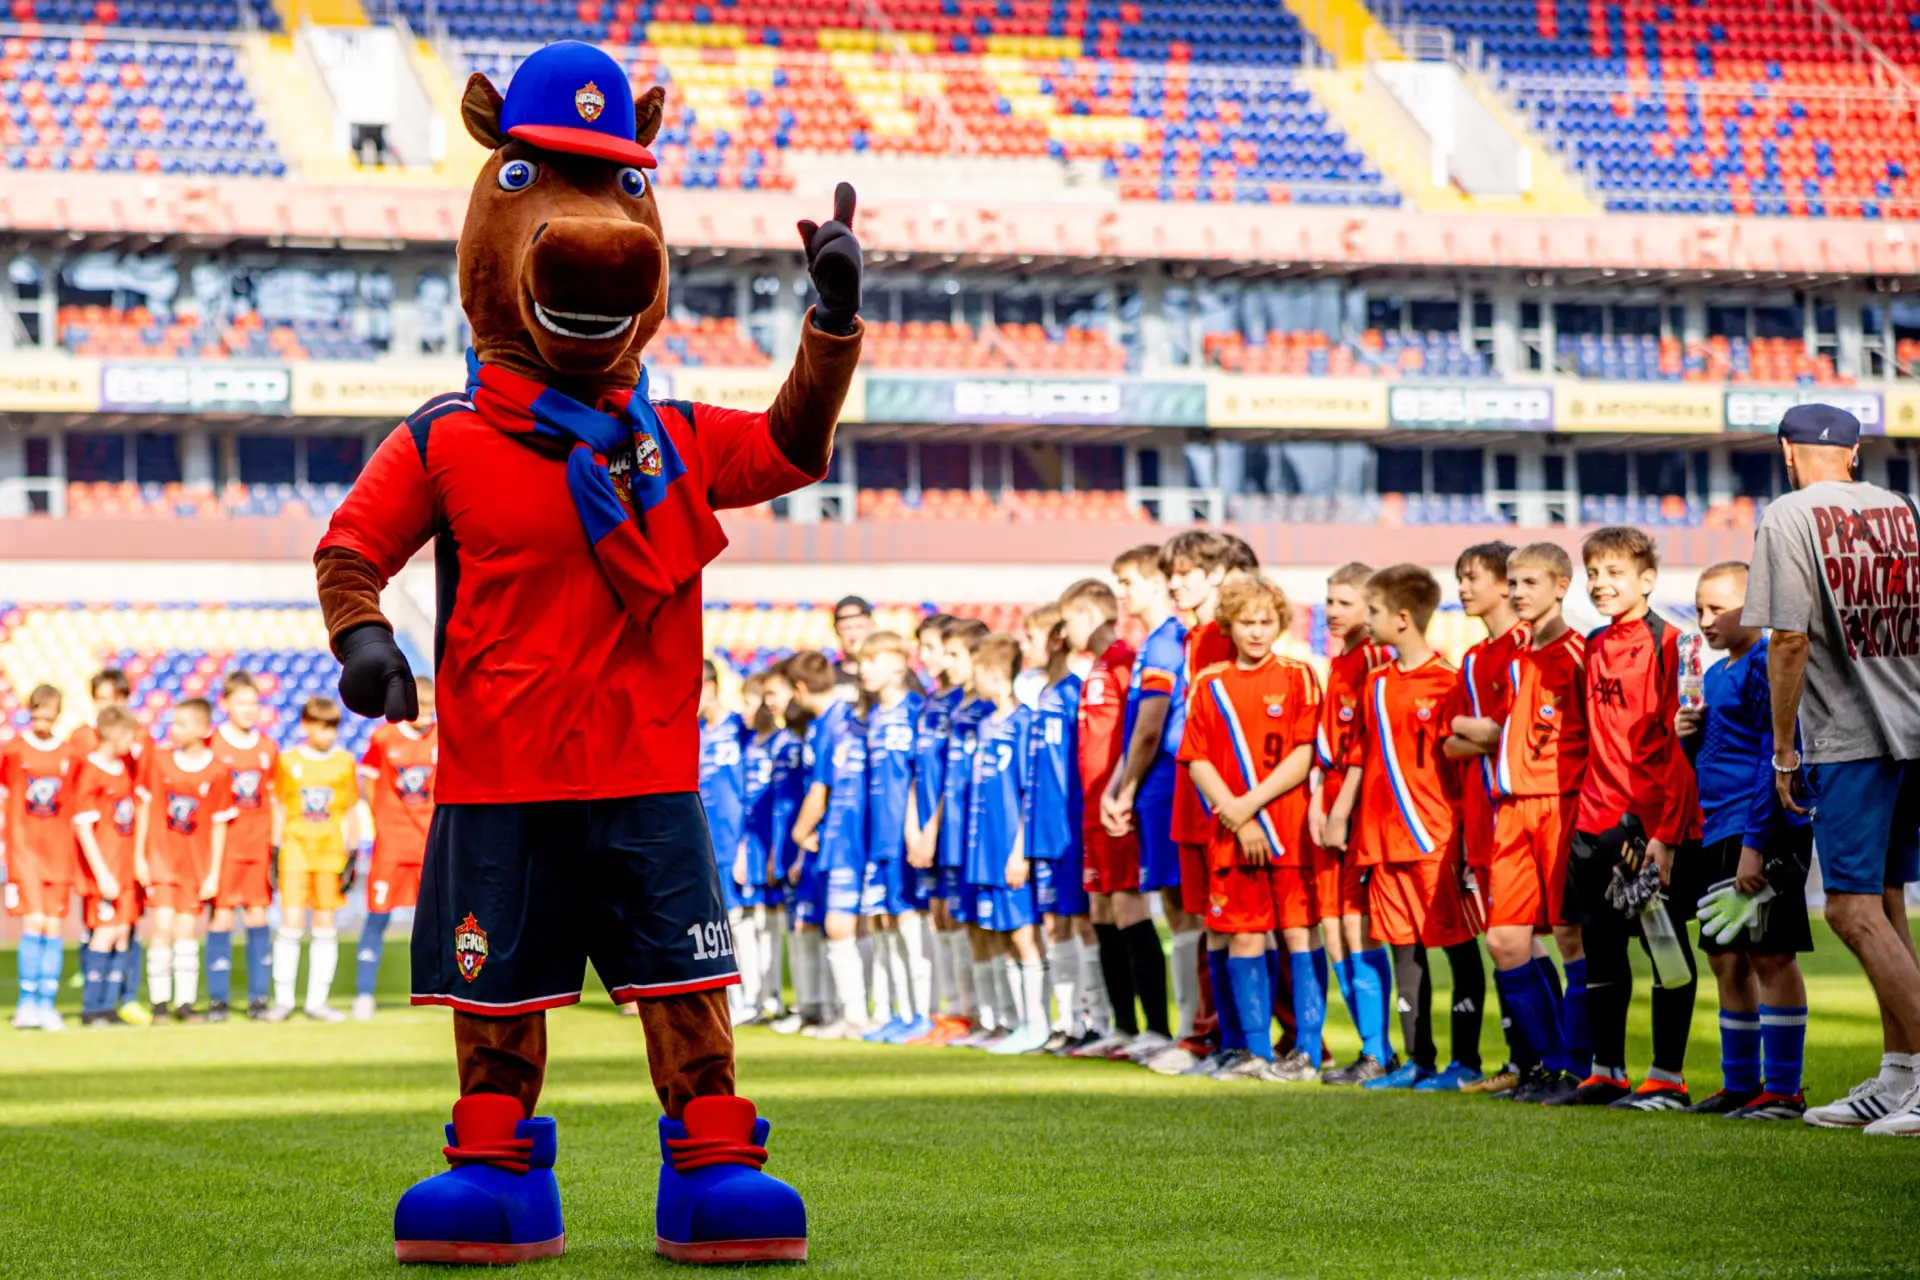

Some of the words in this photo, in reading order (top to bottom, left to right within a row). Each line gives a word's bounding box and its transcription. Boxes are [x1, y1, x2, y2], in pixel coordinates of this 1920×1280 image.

[1812, 505, 1918, 555] PRCTICE
[1824, 556, 1919, 608] PRACTCE
[1263, 732, 1284, 769] 9
[457, 932, 486, 954] ЦСКА
[687, 920, 734, 960] 1911
